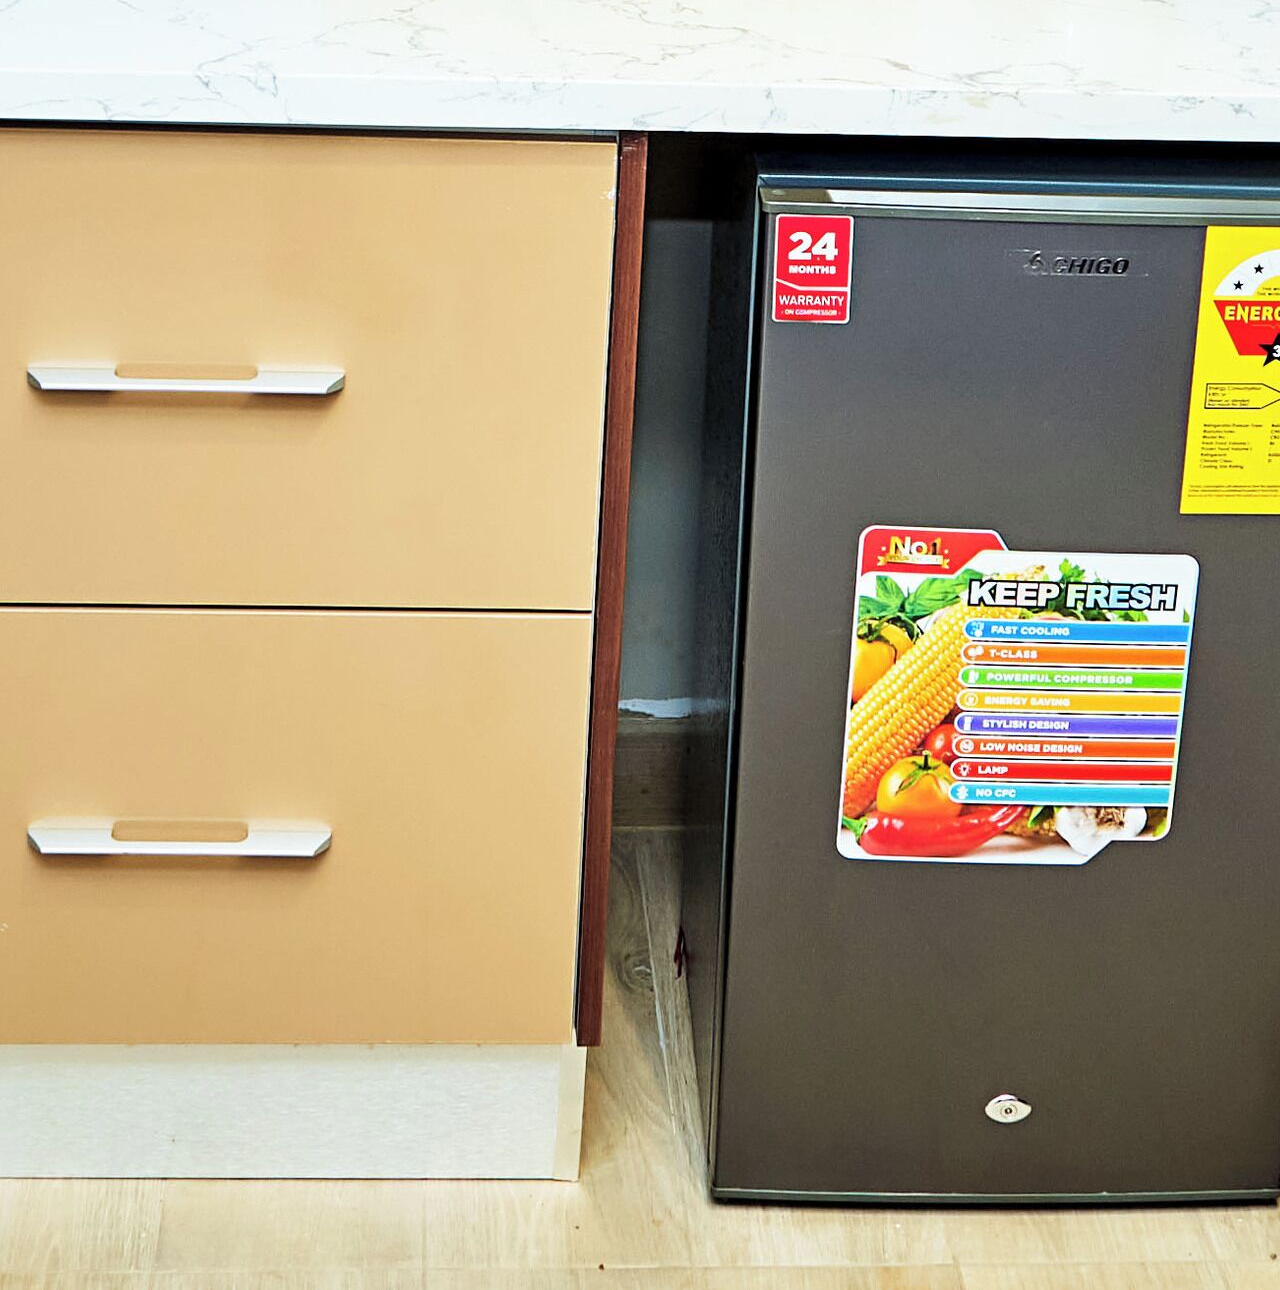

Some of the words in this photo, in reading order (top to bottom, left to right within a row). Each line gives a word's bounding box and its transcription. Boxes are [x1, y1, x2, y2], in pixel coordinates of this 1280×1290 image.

[788, 231, 839, 261] 24
[788, 264, 837, 275] MONTHS
[1054, 256, 1130, 275] CHIGO
[779, 295, 845, 307] WARRANTY
[969, 579, 1060, 608] KEEP
[1066, 582, 1177, 610] FRESH
[991, 625, 1019, 635] FAST
[1020, 626, 1070, 636] COOLING
[989, 649, 1038, 659] T-CLASS
[987, 672, 1051, 683] POWERFUL
[1053, 674, 1134, 685] COMPRESSOR
[984, 695, 1028, 705] ENERGY
[1030, 696, 1071, 707] SAVING
[982, 718, 1028, 729] STYLISH
[1028, 720, 1070, 730] DESIGN
[980, 742, 1006, 751] LOW
[1007, 743, 1041, 752] NOISE
[1042, 744, 1083, 753] DESIGN
[977, 765, 1009, 775] LAMP
[975, 788, 993, 797] NO
[994, 788, 1017, 798] CFC
